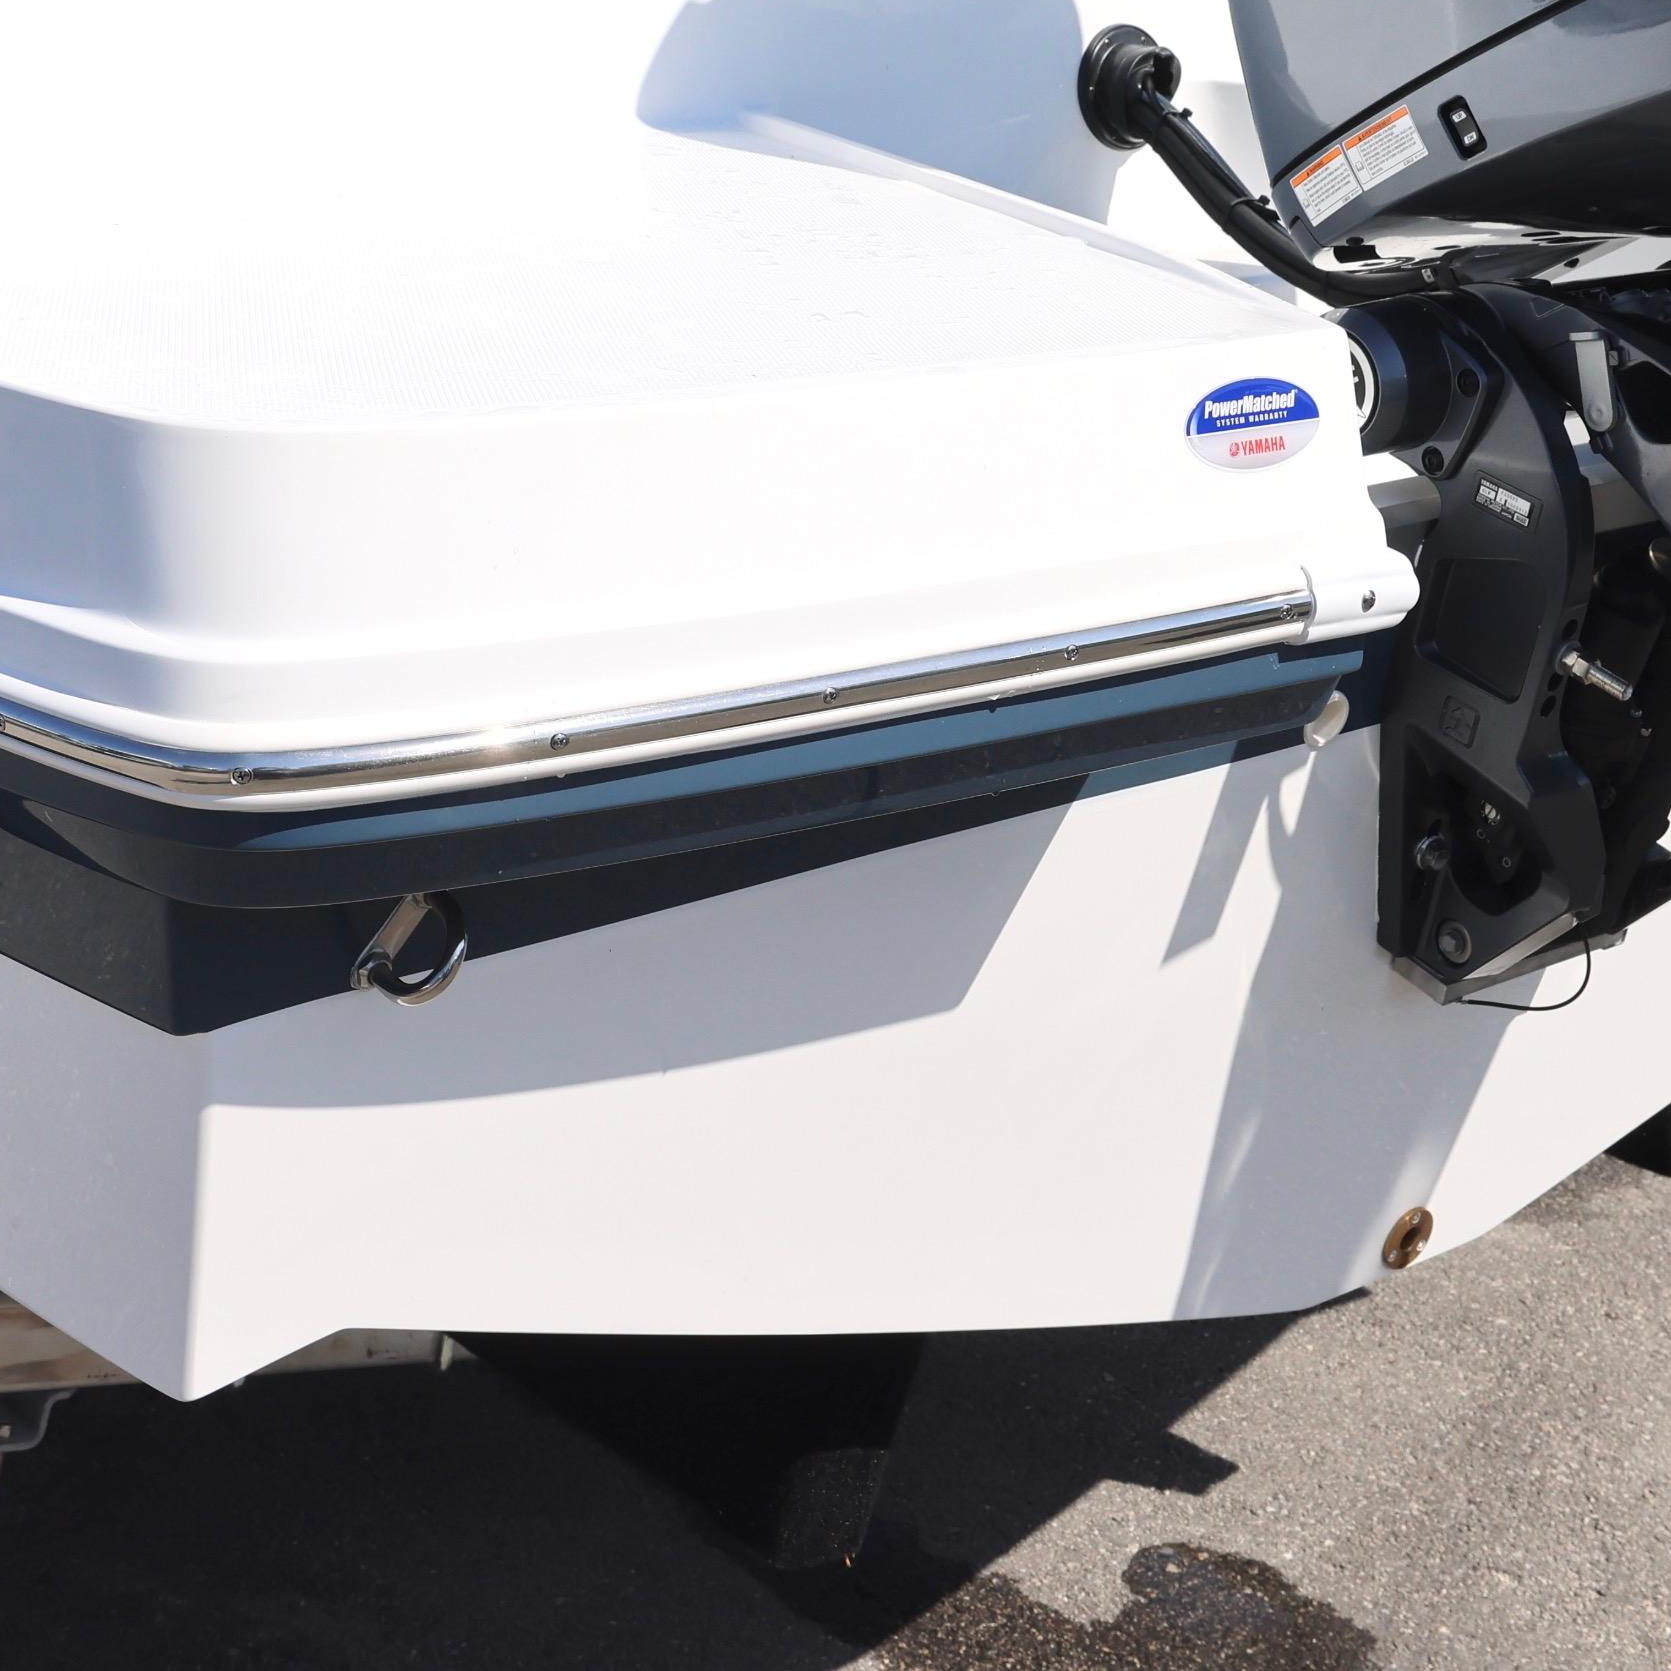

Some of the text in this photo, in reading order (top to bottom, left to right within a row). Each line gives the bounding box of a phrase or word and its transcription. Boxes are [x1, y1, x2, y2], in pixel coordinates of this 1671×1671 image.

[1204, 389, 1296, 419] PowerMatched
[1216, 410, 1288, 427] SYSTEM WARRANTY
[1240, 435, 1286, 456] YAMAHA
